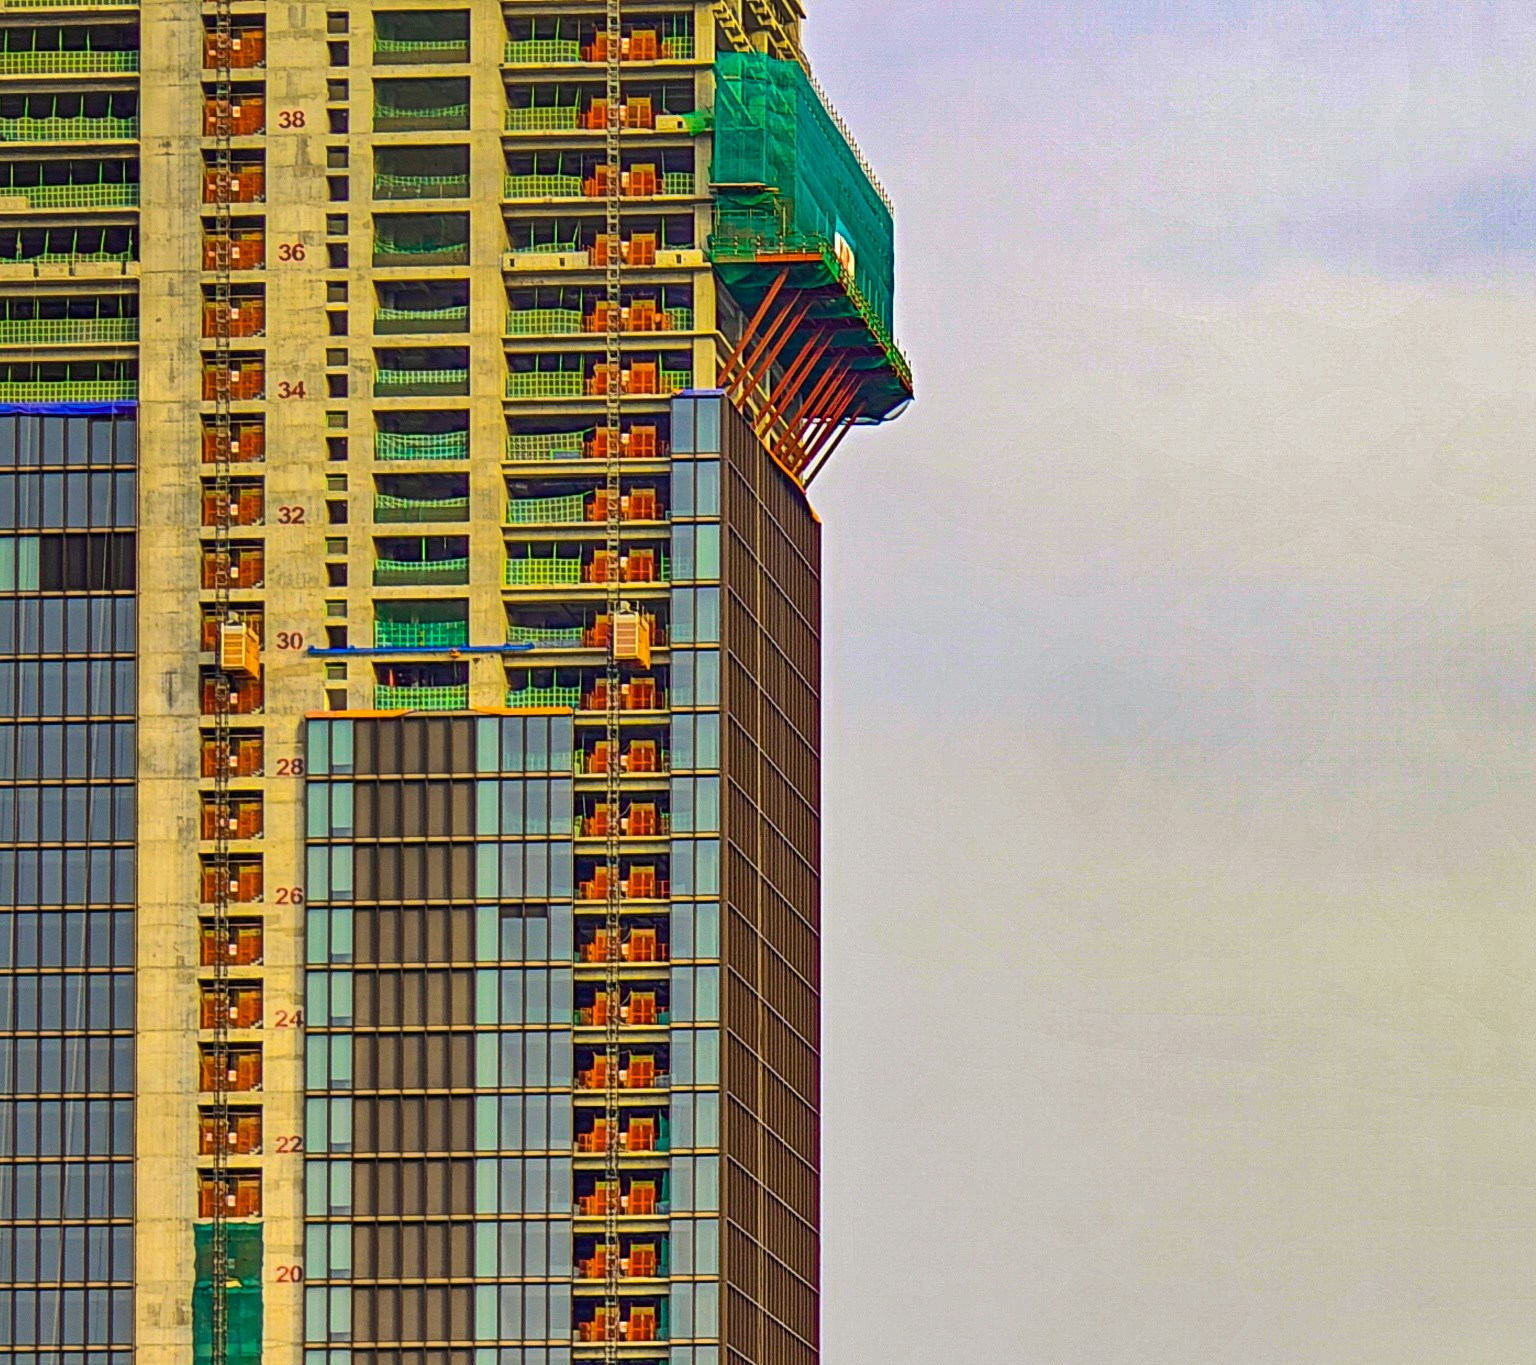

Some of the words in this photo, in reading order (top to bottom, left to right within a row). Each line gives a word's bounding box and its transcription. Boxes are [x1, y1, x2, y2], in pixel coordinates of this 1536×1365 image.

[278, 110, 306, 129] 38
[278, 243, 306, 262] 36
[277, 380, 306, 400] 34
[278, 506, 305, 525] 32
[276, 632, 303, 650] 30
[276, 758, 304, 776] 28
[275, 887, 304, 905] 26
[275, 1009, 304, 1028] 24
[275, 1135, 304, 1154] 22
[275, 1265, 303, 1283] 20
